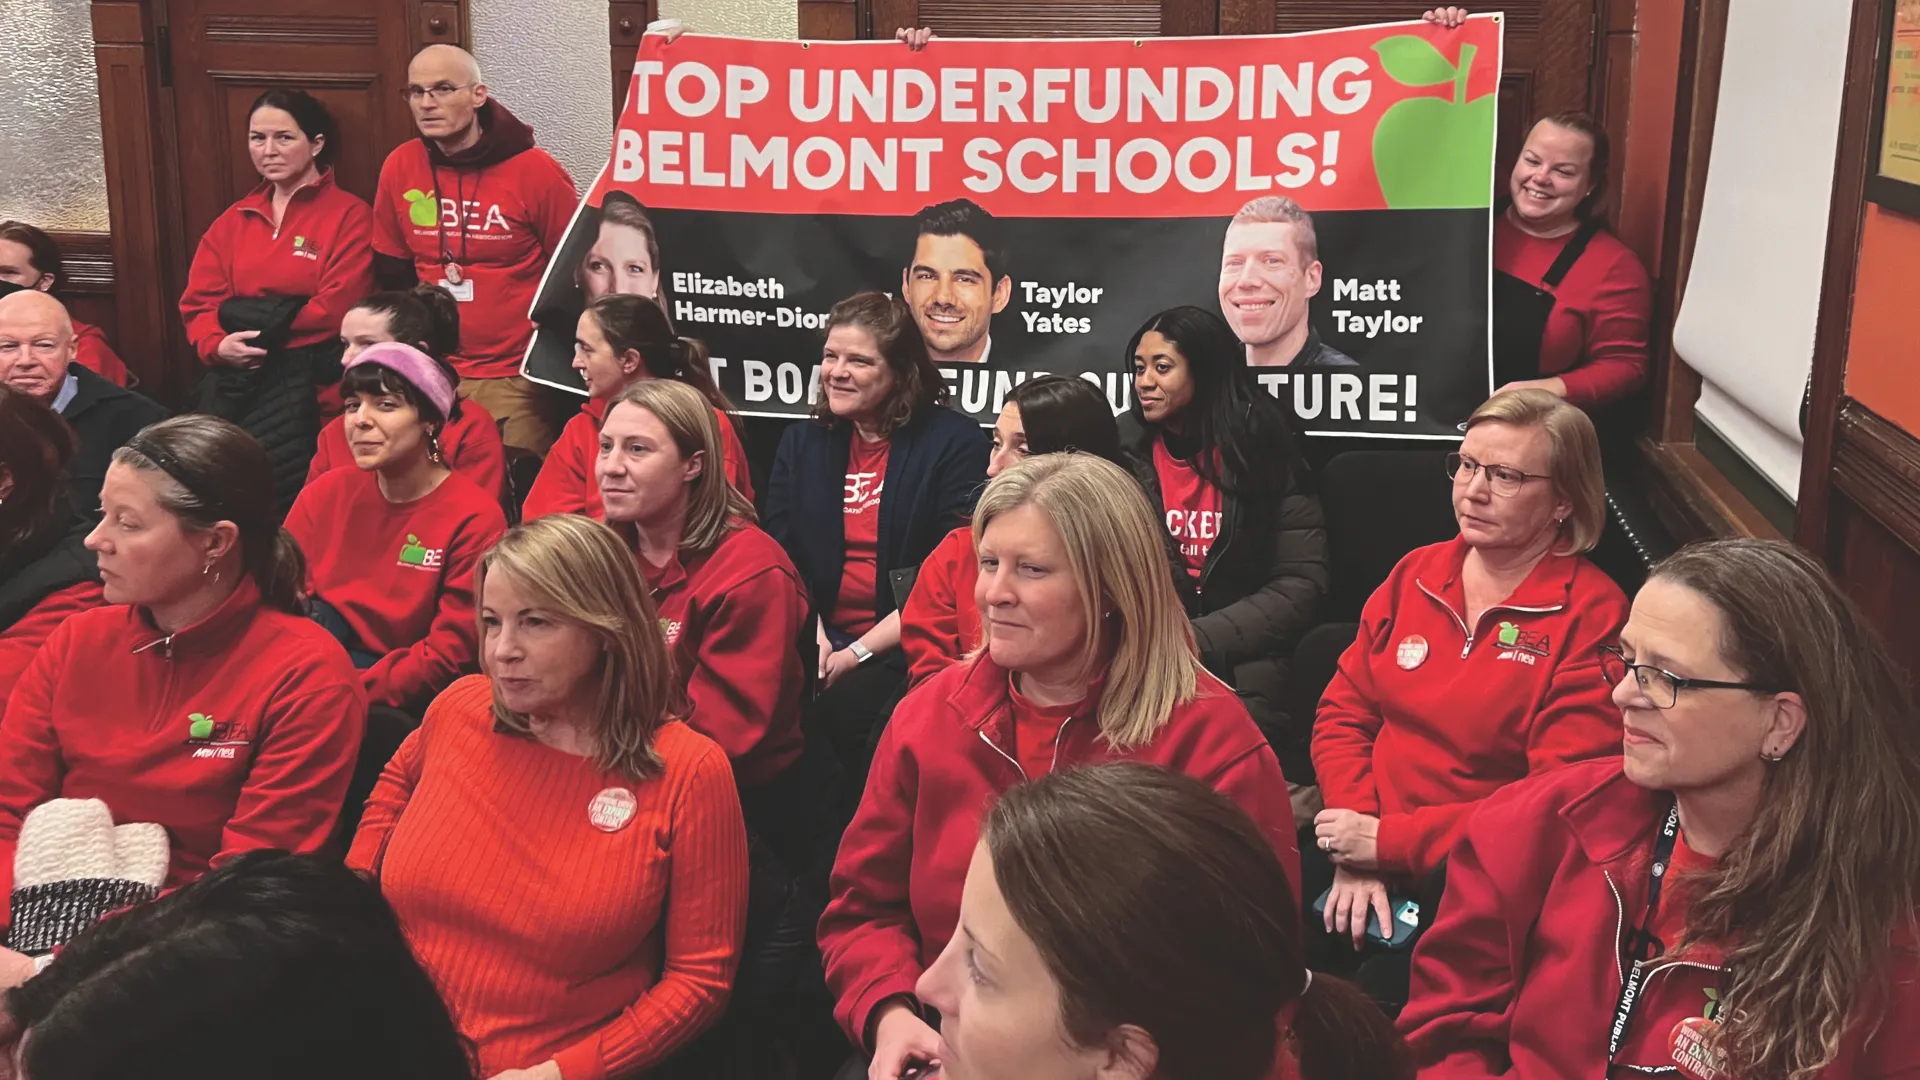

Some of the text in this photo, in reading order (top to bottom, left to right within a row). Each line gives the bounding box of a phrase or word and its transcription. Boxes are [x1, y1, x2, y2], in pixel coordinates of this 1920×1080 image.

[788, 56, 1373, 124] UNDERFUNDING
[612, 128, 1340, 193] BELMONT SCHOOLS!
[440, 197, 512, 232] BEA
[672, 271, 785, 300] Elizabeth
[1020, 281, 1103, 305] Taylor
[1332, 278, 1401, 302] Matt
[1021, 312, 1092, 335] Yates
[1332, 310, 1423, 339] Taylor
[1609, 958, 1643, 1054] BELMONT PUBLIC
[1673, 1032, 1691, 1051] AN
[1671, 1047, 1716, 1080] CONTRACT
